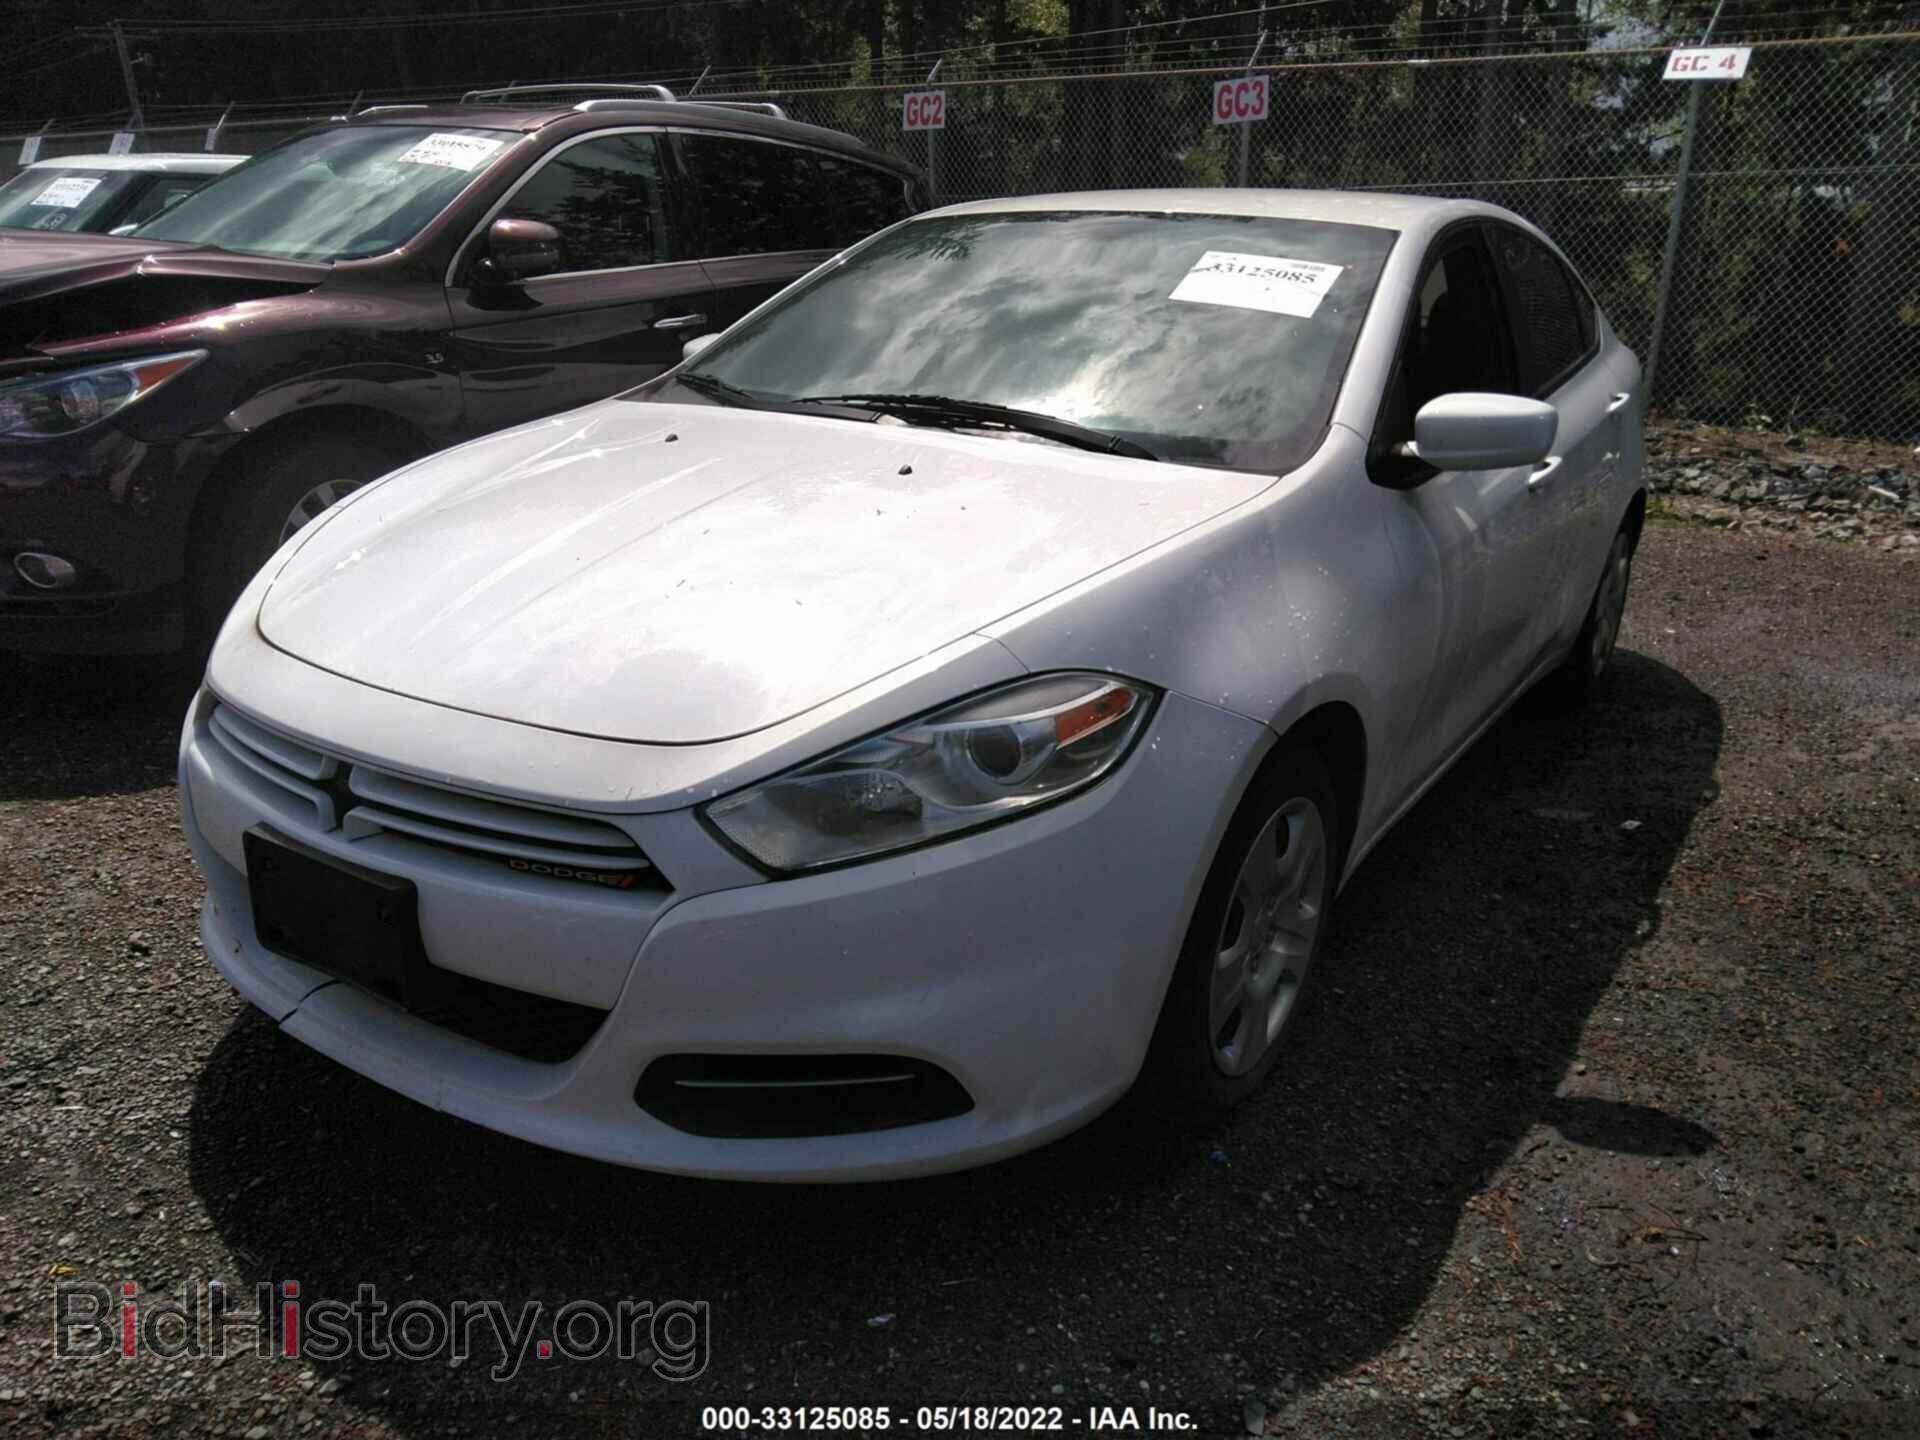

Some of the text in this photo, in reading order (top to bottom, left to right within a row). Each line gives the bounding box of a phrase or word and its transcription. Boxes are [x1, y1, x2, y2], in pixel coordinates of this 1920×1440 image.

[1671, 54, 1736, 72] GC 4
[907, 95, 943, 127] GC2
[1217, 80, 1265, 119] GC3
[509, 859, 625, 885] DODGE
